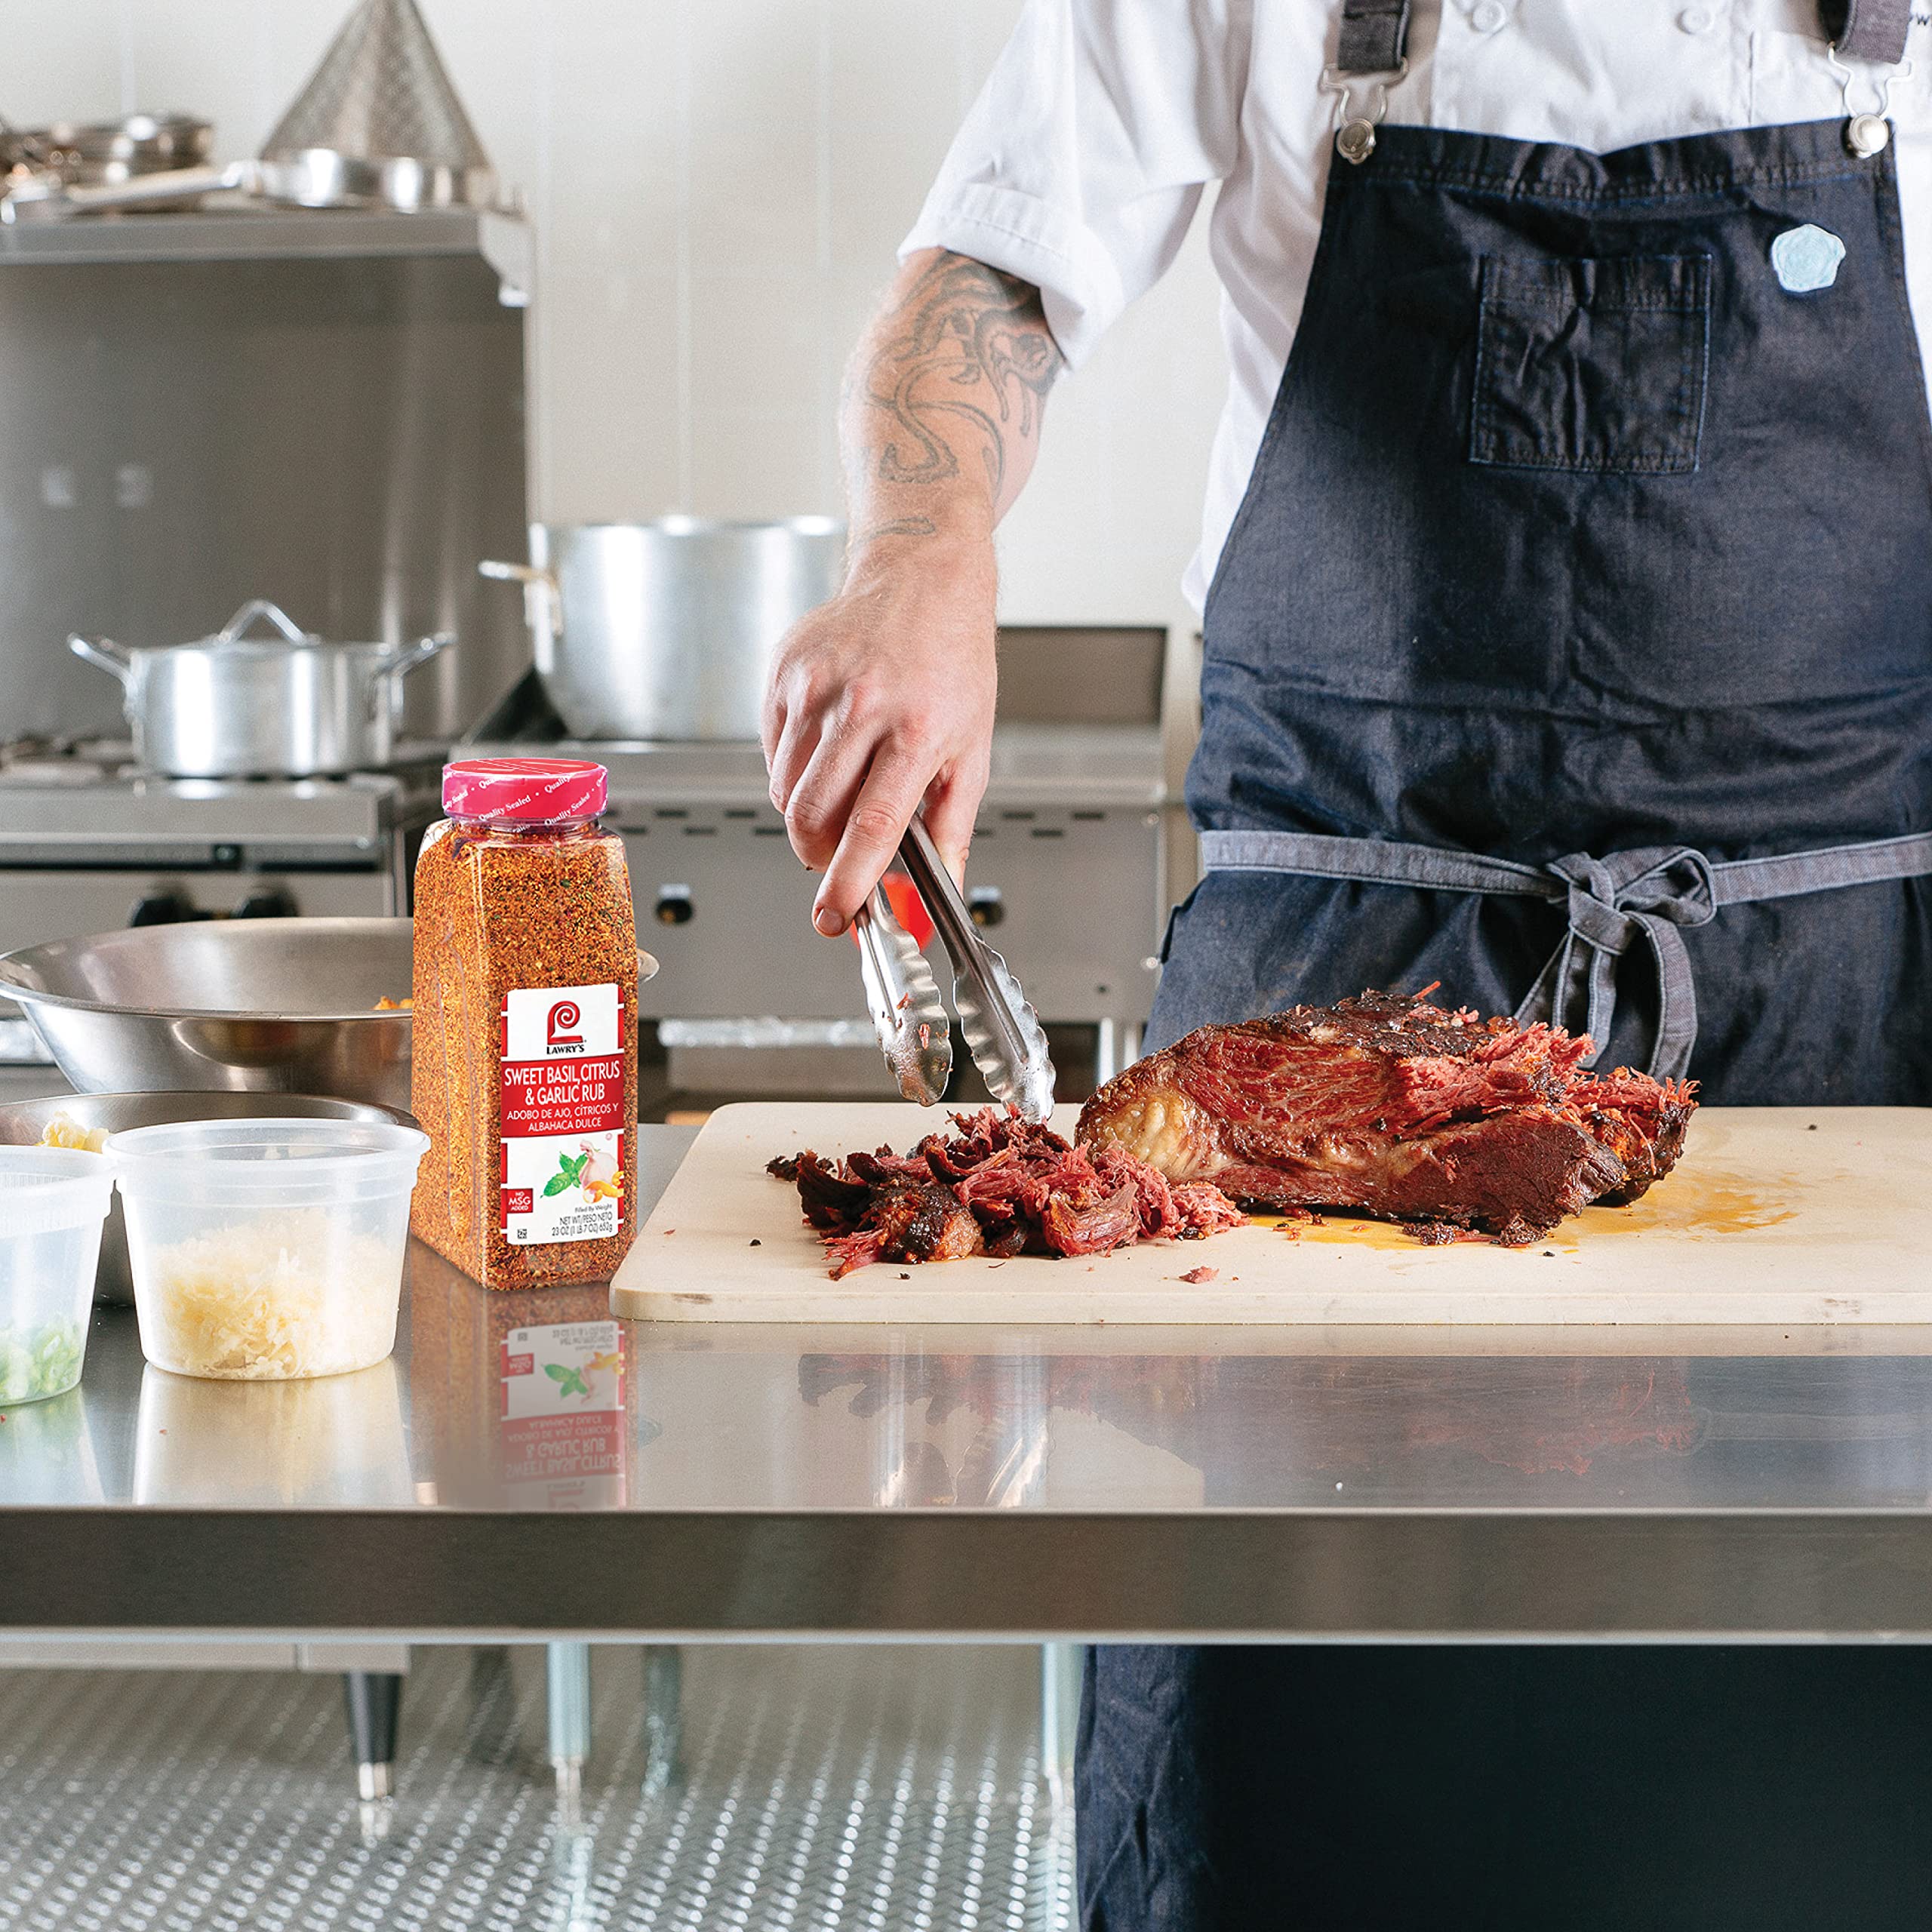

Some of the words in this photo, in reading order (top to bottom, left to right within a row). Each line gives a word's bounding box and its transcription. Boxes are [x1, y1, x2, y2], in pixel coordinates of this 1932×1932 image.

[544, 774, 571, 793] Quality
[478, 807, 505, 822] Quality
[505, 795, 531, 811] Sealed
[544, 808, 571, 826] Quality
[571, 792, 590, 811] Sealed
[546, 1044, 585, 1054] LAWRY'S
[504, 1067, 544, 1086] SWEET
[547, 1065, 580, 1085] BASIL,
[580, 1060, 620, 1081] CITRUS
[525, 1088, 534, 1106] &
[537, 1085, 580, 1105] GARLIC
[582, 1083, 605, 1102] RUB
[507, 1110, 539, 1120] ADOBO
[541, 1109, 552, 1118] DE
[555, 1107, 573, 1118] AJO,
[574, 1103, 611, 1116] CÍTRICOS
[613, 1103, 619, 1112] Y
[528, 1120, 574, 1132] ALBAHACA
[575, 1117, 601, 1128] DULCE
[508, 1196, 531, 1205] MSG
[560, 1216, 571, 1225] NET
[598, 1211, 613, 1221] NETO
